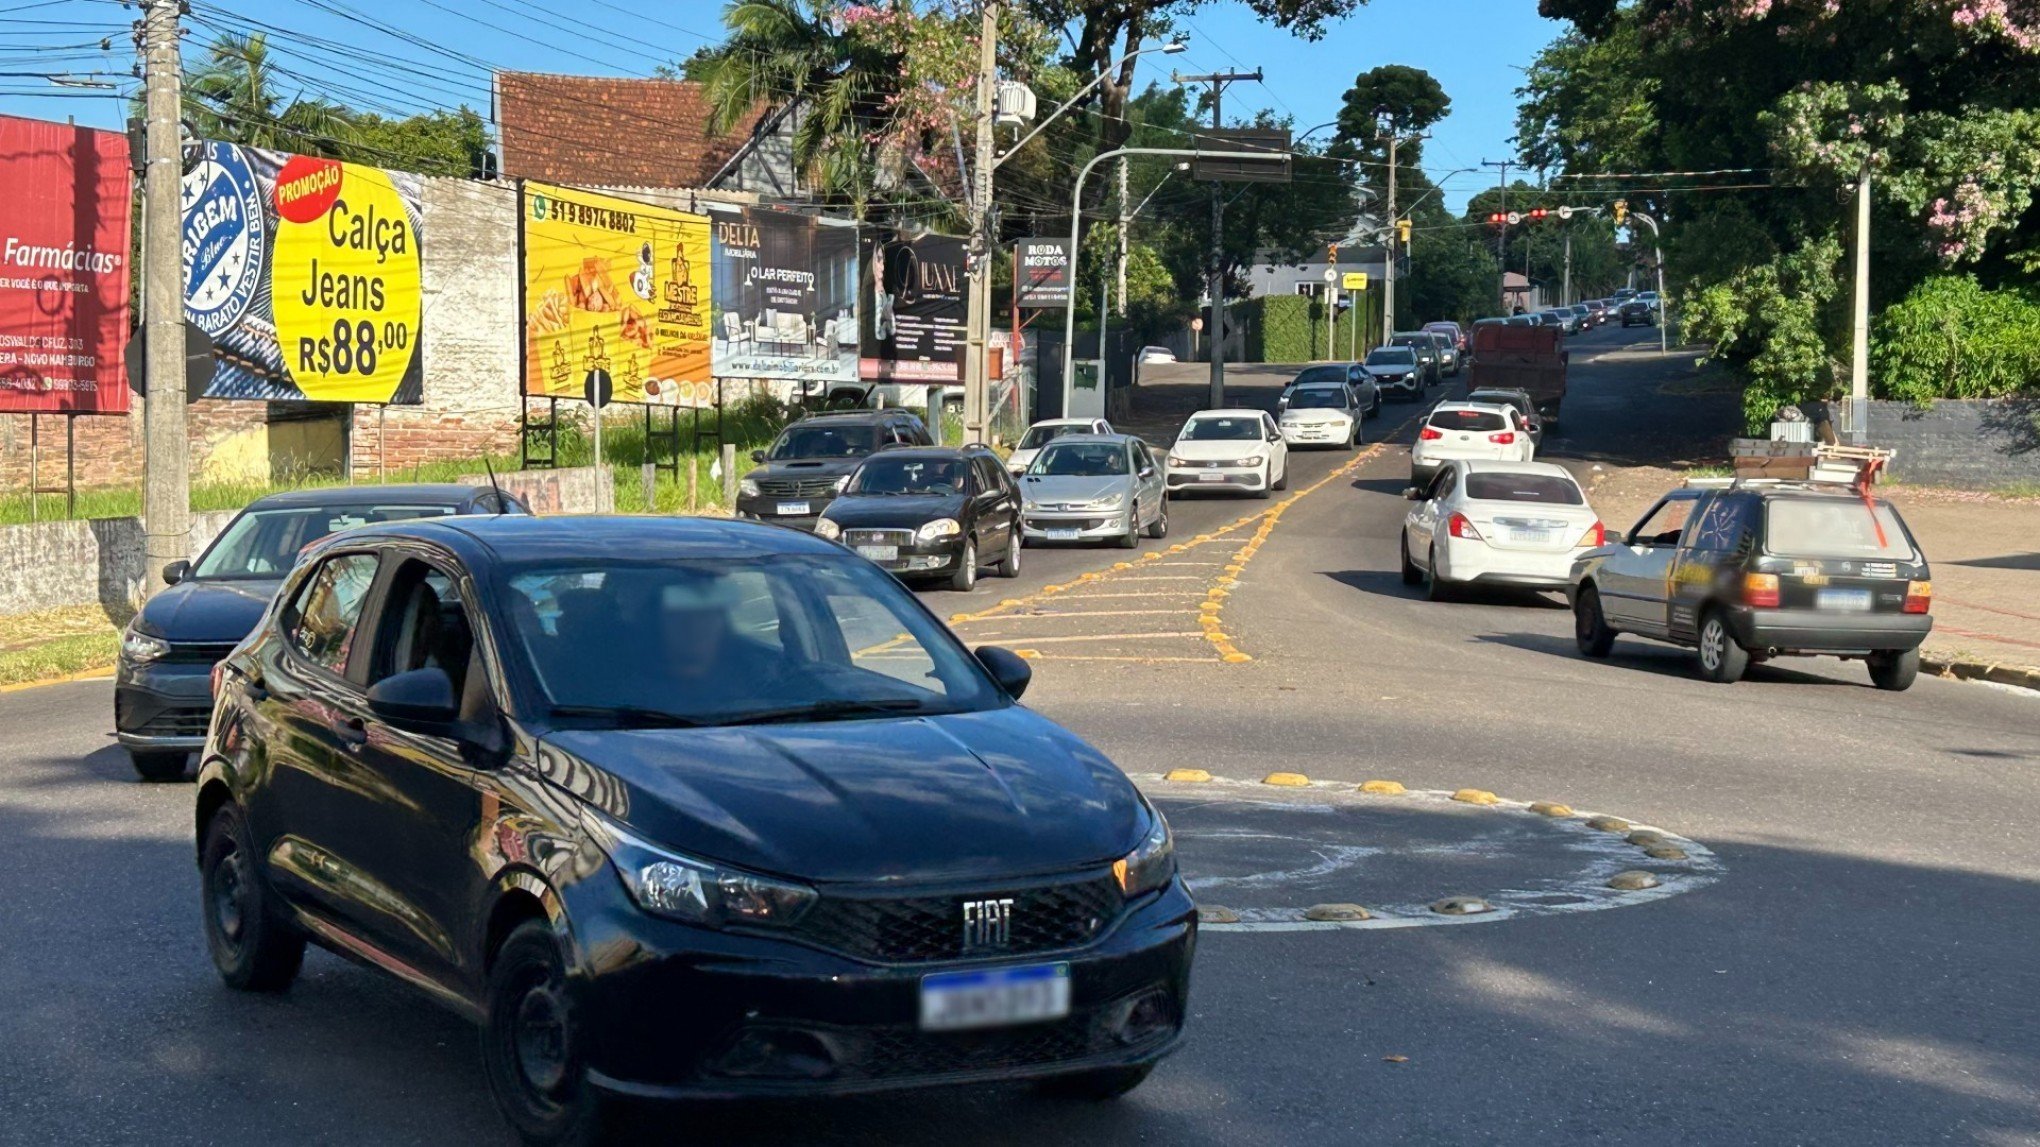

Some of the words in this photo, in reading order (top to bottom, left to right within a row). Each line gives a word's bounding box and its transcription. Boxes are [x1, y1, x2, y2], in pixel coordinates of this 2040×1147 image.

[278, 165, 339, 205] PROMOÇÃO
[245, 192, 260, 232] BEM
[551, 200, 565, 221] 51
[569, 202, 576, 222] 9
[578, 205, 606, 228] 8974
[609, 210, 636, 233] 8802
[329, 199, 406, 264] Calça
[718, 221, 760, 248] DELTA
[1024, 255, 1068, 267] MOTOS
[1028, 244, 1064, 255] RODA
[11, 278, 31, 290] VOCÊ
[236, 238, 260, 298] VESTIR
[302, 258, 385, 312] Jeans
[750, 266, 758, 278] O
[759, 267, 776, 280] LAR
[777, 269, 815, 284] PERFEITO
[197, 295, 240, 332] BARATO
[24, 353, 48, 366] NOVO
[49, 354, 95, 368] HAMBURGO
[963, 898, 1014, 946] FIAT
